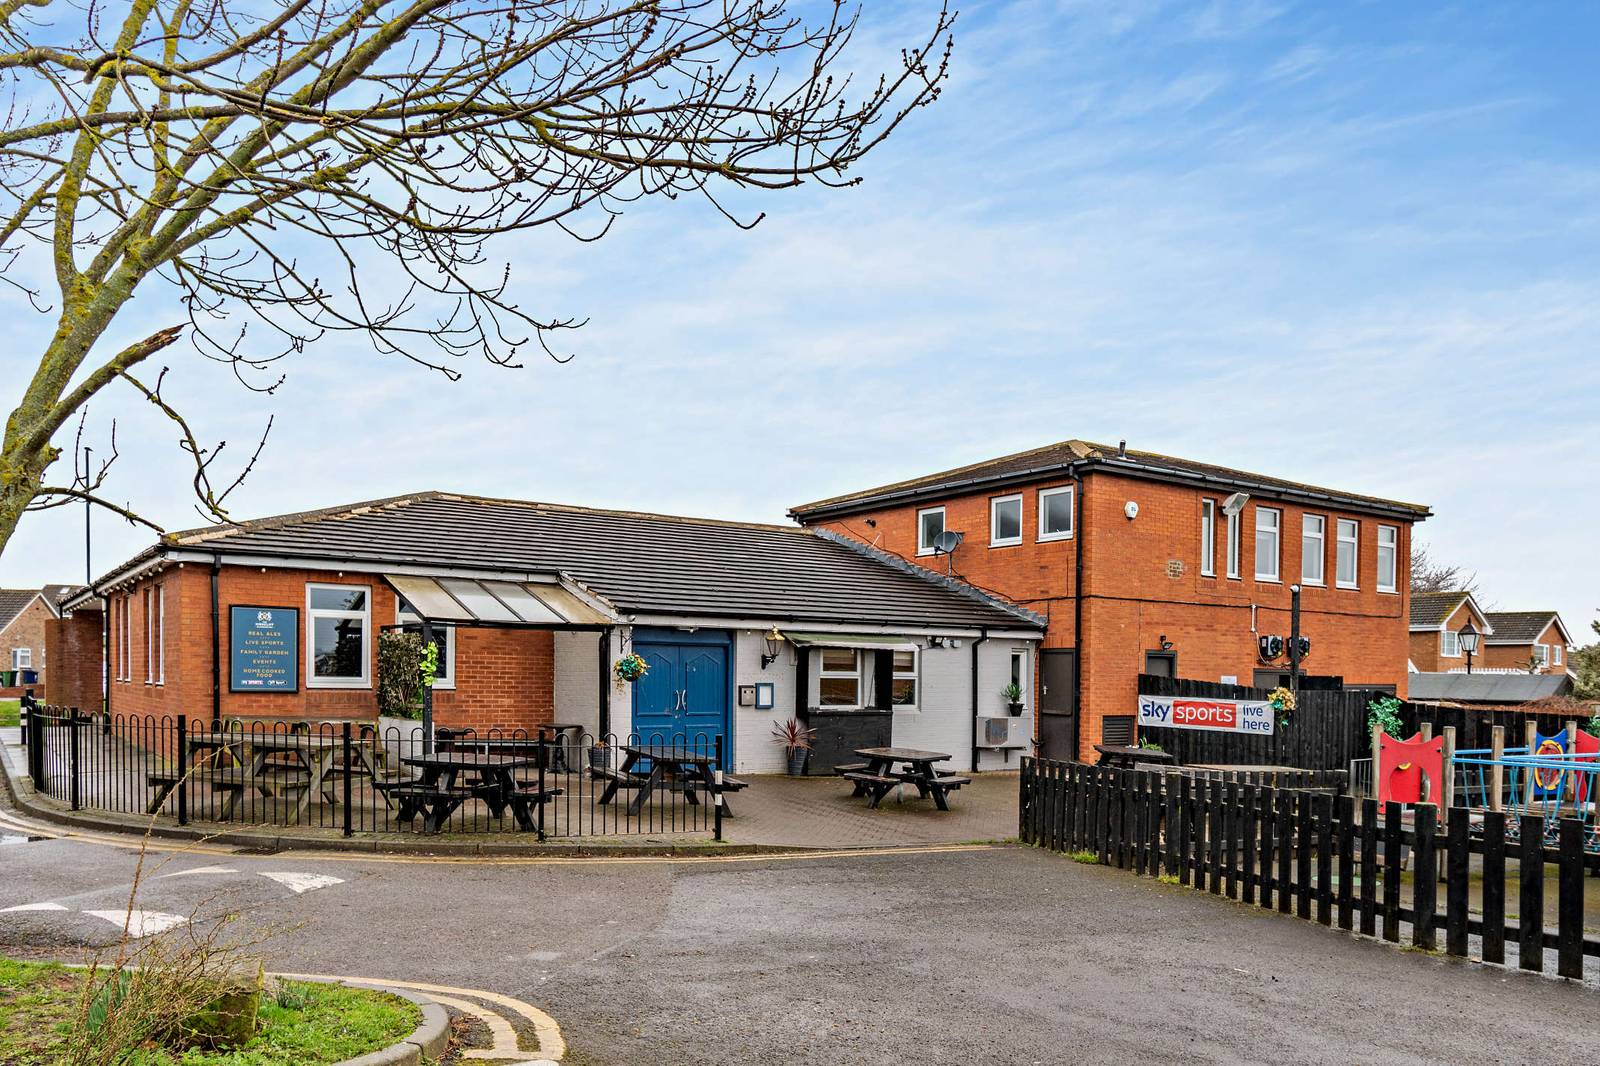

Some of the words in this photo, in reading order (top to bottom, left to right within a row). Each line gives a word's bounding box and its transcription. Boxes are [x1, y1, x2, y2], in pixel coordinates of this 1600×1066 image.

[1142, 701, 1170, 722] sky
[1176, 706, 1233, 723] sports
[1243, 705, 1263, 717] live
[1243, 718, 1270, 730] here
